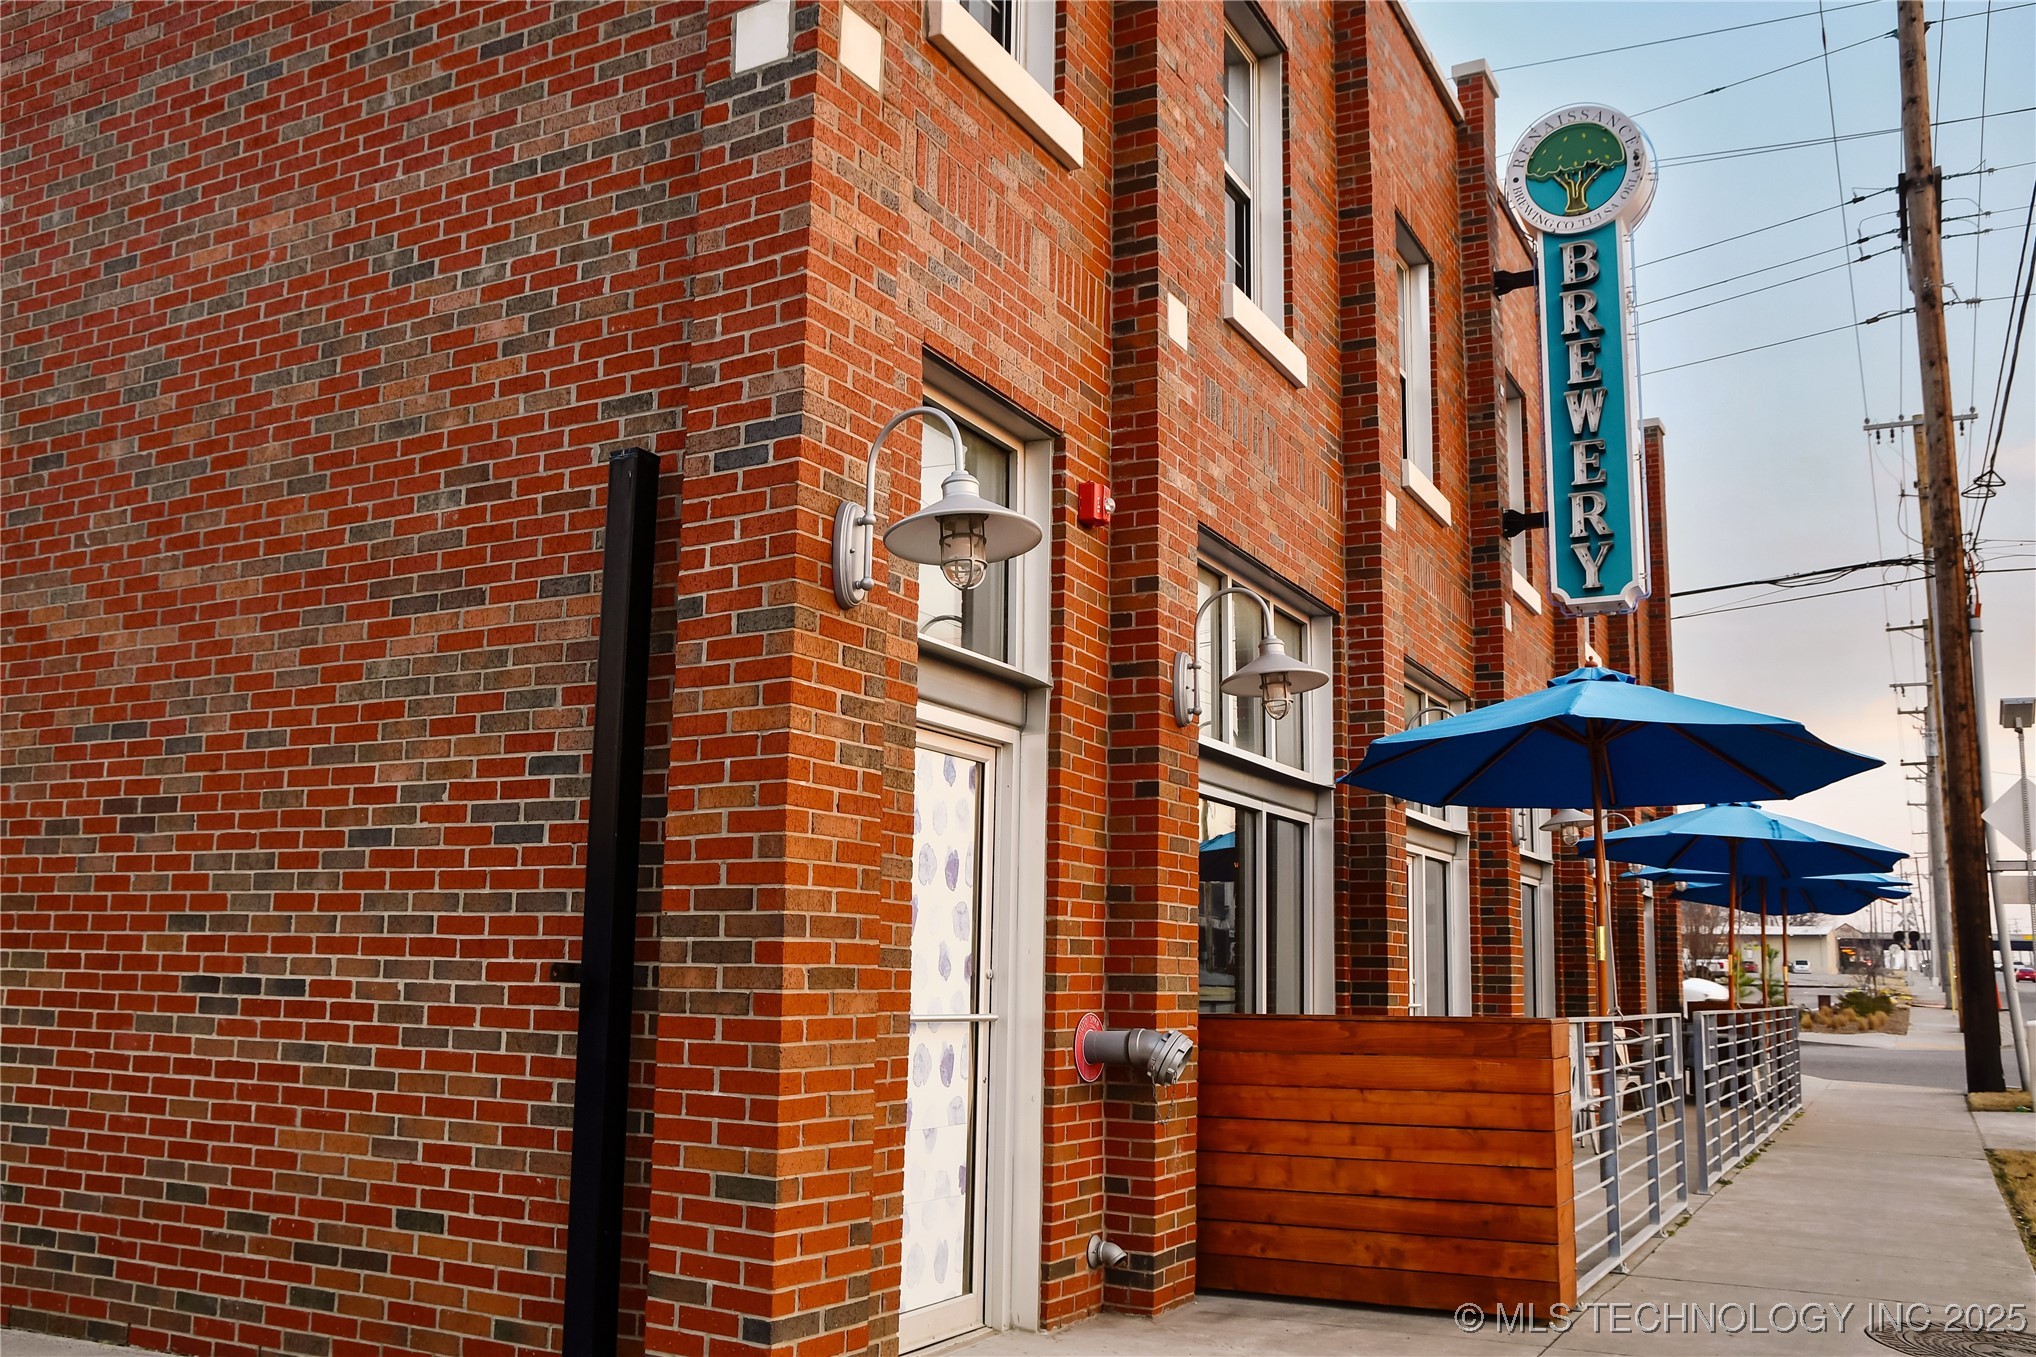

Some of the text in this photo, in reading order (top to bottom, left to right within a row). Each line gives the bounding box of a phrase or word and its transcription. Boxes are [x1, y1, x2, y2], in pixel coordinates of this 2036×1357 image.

[1513, 108, 1640, 168] RENAISSANCE
[1513, 186, 1553, 228] BREWING
[1556, 220, 1574, 229] CO
[1578, 203, 1619, 226] TULSA
[1559, 240, 1614, 590] BREWERY
